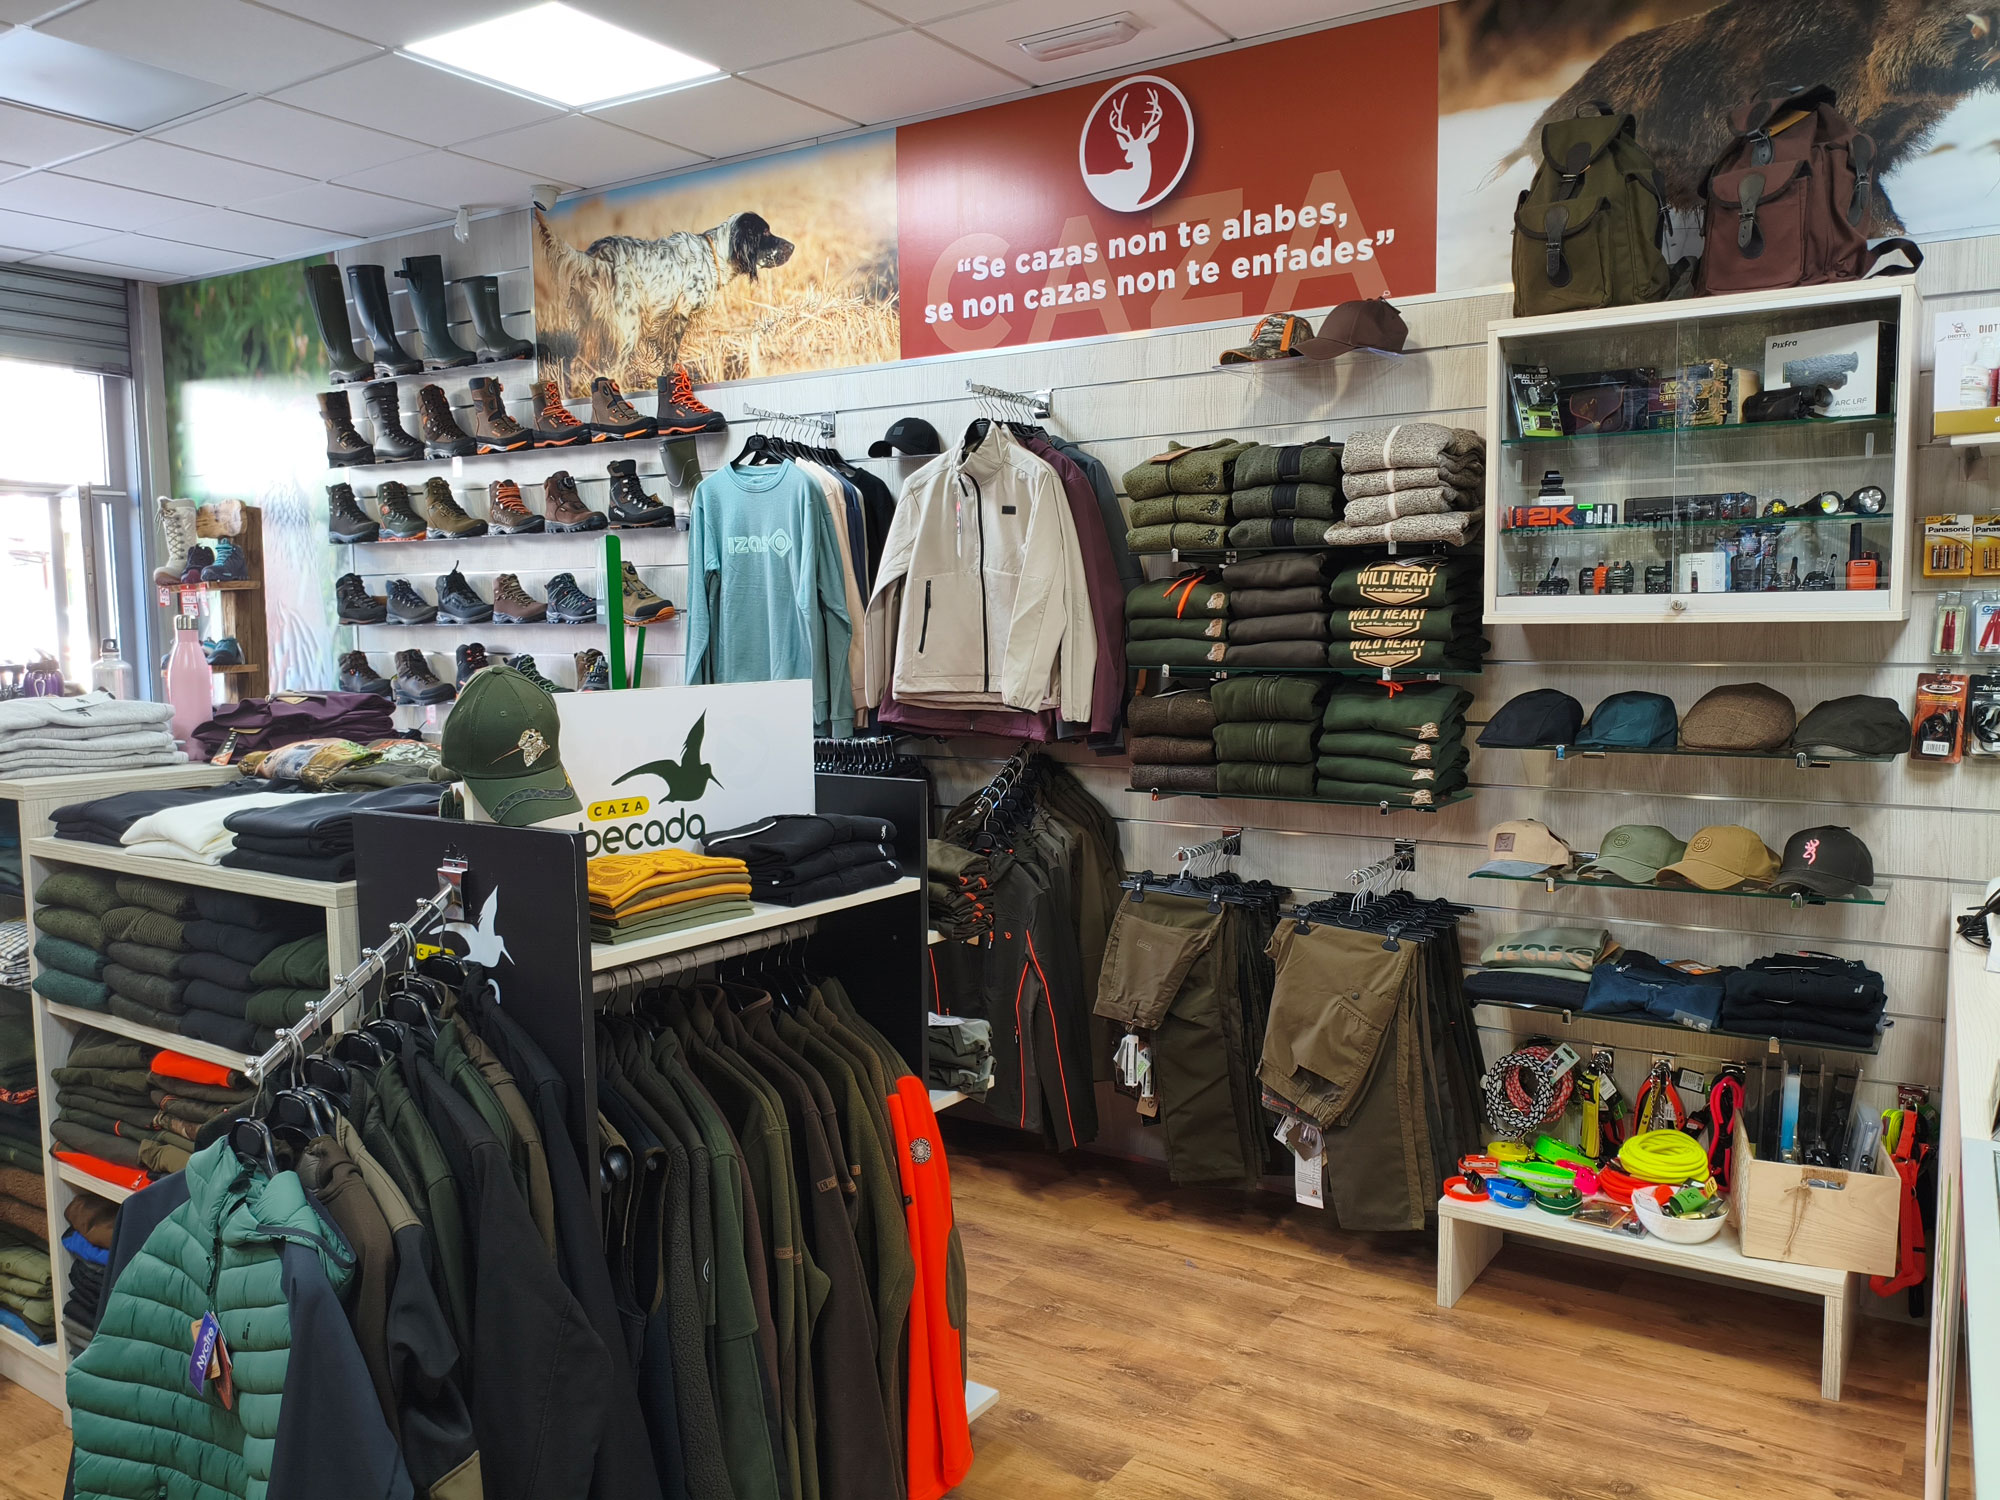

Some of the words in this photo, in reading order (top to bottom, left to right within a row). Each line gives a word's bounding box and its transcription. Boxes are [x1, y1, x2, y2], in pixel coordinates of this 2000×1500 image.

[1015, 242, 1098, 275] cazas
[1108, 230, 1167, 259] non
[1177, 218, 1211, 249] te
[1222, 201, 1348, 242] alabes,
[924, 301, 952, 325] se
[962, 291, 1014, 319] non
[1023, 279, 1107, 311] cazas
[1116, 266, 1176, 297] non
[1186, 256, 1220, 286] te
[1979, 323, 2000, 334] DIOT
[1528, 507, 1575, 526] 2K
[1357, 571, 1390, 585] WILD
[1392, 572, 1437, 586] HEART
[1348, 609, 1380, 621] WILD
[1382, 608, 1428, 620] HEART
[1349, 640, 1381, 650] WILD
[594, 801, 643, 817] CAZA
[579, 807, 706, 858] becada
